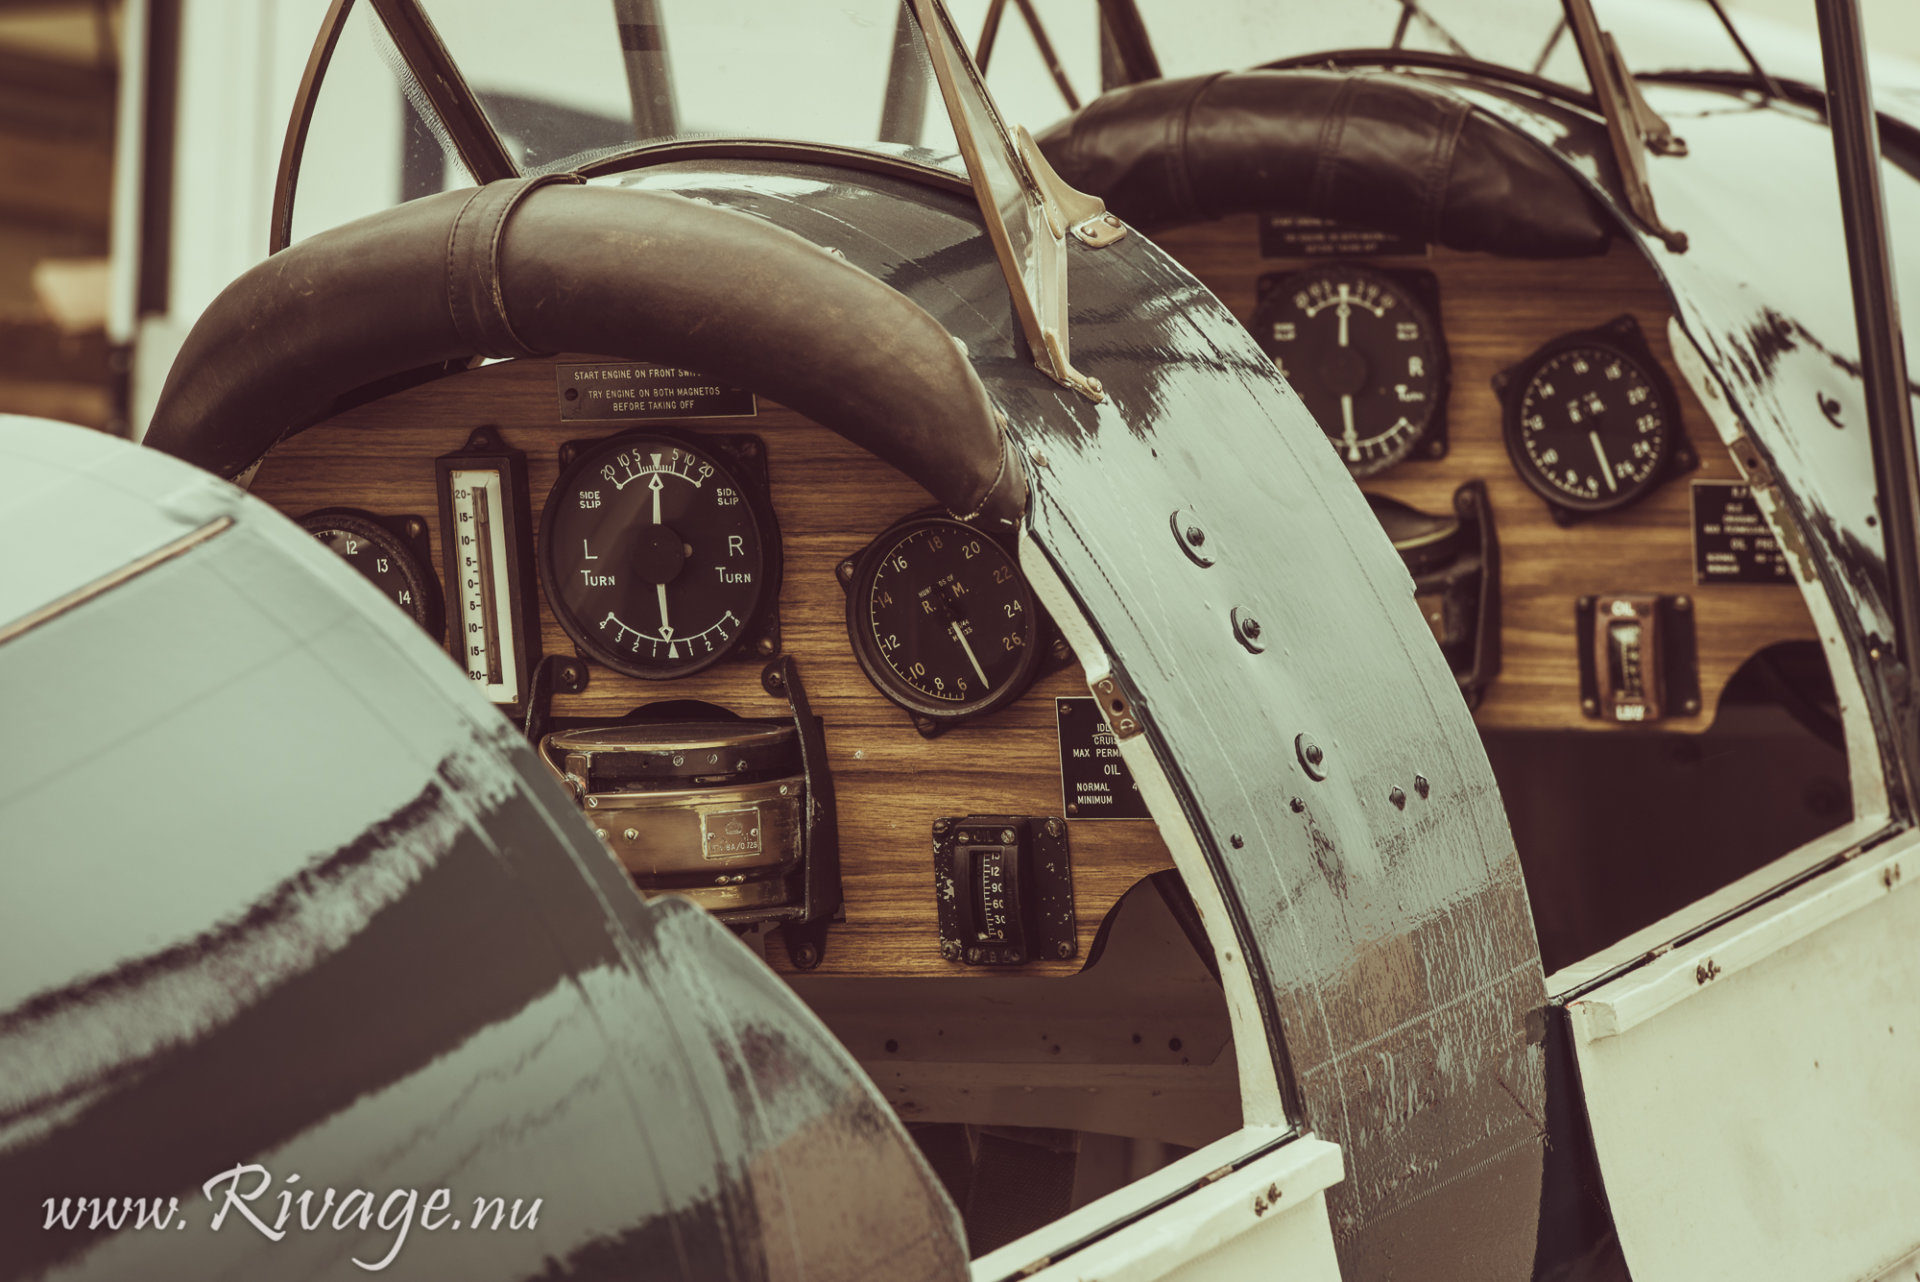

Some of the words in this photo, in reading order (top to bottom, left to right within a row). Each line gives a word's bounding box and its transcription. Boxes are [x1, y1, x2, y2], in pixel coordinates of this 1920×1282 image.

[1408, 356, 1424, 377] R
[574, 371, 598, 380] START
[602, 370, 631, 380] ENGINE
[635, 369, 646, 379] ON
[649, 368, 675, 378] FRONT
[588, 390, 602, 399] TRY
[606, 389, 635, 398] ENGINE
[639, 388, 650, 398] ON
[653, 388, 674, 398] BOTH
[677, 386, 720, 396] MAGNETOS
[613, 401, 646, 412] BEFORE
[649, 400, 677, 410] TAKING
[680, 400, 694, 409] OFF
[617, 453, 630, 468] 10
[632, 448, 640, 462] 5
[672, 448, 679, 461] 5
[684, 453, 696, 466] 10
[600, 464, 616, 480] 20
[698, 462, 714, 478] 20
[455, 490, 466, 498] 20
[580, 490, 600, 500] SIDE
[580, 500, 601, 509] SLIP
[717, 497, 739, 506] SLIP
[459, 512, 468, 522] 15
[461, 536, 470, 546] 10
[728, 536, 744, 556] R
[928, 536, 943, 552] 18
[346, 540, 358, 555] 12
[584, 539, 598, 560] L
[962, 541, 980, 559] 20
[376, 558, 389, 572] 13
[466, 558, 472, 566] 5
[892, 556, 908, 572] 16
[993, 566, 1012, 584] 22
[952, 581, 969, 598] M.
[398, 590, 411, 604] 14
[878, 592, 893, 608] 14
[470, 601, 476, 610] 5
[1004, 600, 1022, 618] 24
[468, 622, 478, 632] 10
[615, 632, 622, 642] 3
[720, 631, 728, 640] 3
[632, 642, 639, 652] 2
[705, 641, 713, 652] 2
[884, 634, 900, 650] 12
[470, 646, 480, 656] 15
[470, 670, 482, 680] 20
[910, 662, 925, 680] 10
[934, 677, 944, 690] 8
[958, 678, 967, 690] 6
[1097, 724, 1111, 732] IDL
[1073, 748, 1090, 758] MAX
[1104, 764, 1122, 776] OIL
[1076, 782, 1110, 792] NORMAL
[1078, 795, 1112, 804] MINIMUM
